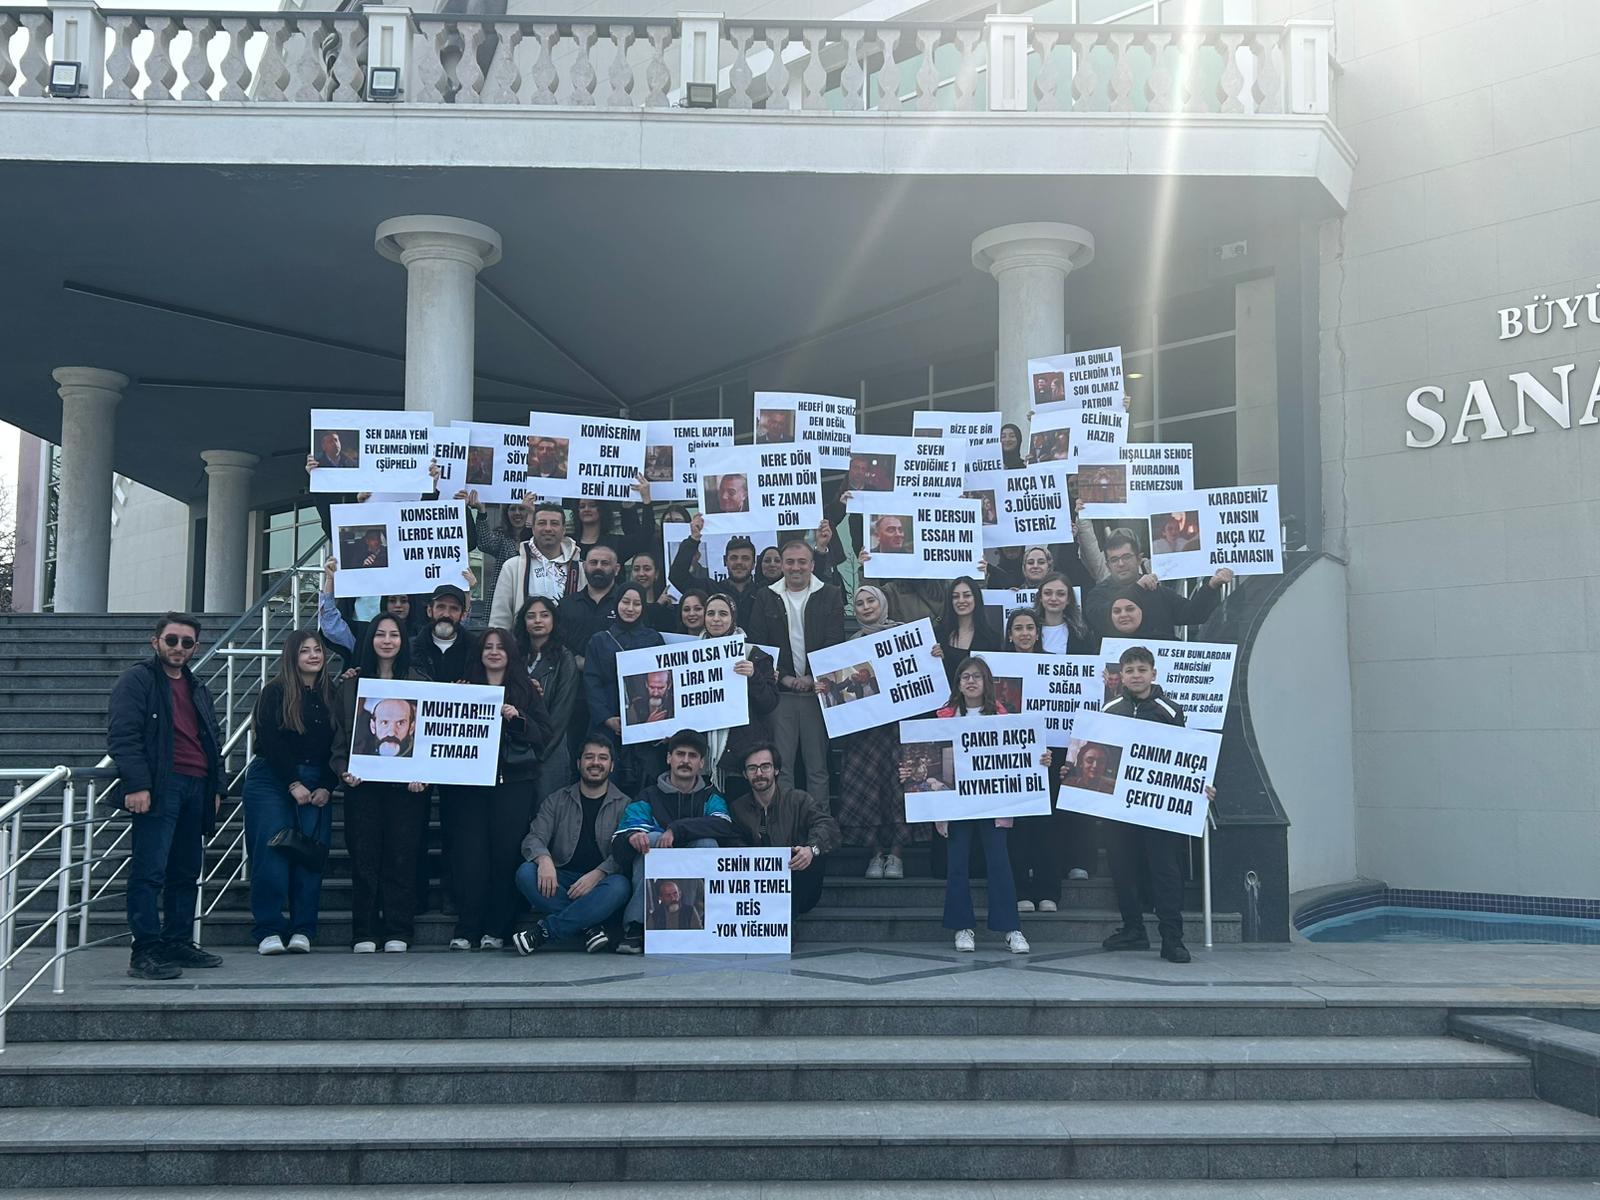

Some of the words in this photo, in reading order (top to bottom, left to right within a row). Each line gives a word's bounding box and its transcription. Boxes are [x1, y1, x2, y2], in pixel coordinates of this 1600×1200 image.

[1075, 356, 1086, 366] HA
[1088, 352, 1114, 364] BUNLA
[1070, 367, 1108, 382] EVLENDİM
[1111, 366, 1121, 376] YA
[1074, 385, 1089, 396] SON
[1092, 382, 1119, 394] OLMAZ
[798, 401, 824, 412] HEDEFİ
[826, 404, 835, 413] ON
[838, 404, 856, 416] SEKİZ
[1082, 397, 1112, 408] PATRON
[810, 416, 824, 426] DEN
[826, 416, 845, 428] DEĞİL
[1082, 412, 1122, 428] GELİNLİK
[366, 429, 382, 440] SEN
[384, 429, 407, 440] DAHA
[410, 428, 428, 440] YENİ
[581, 424, 640, 442] KOMİSERİM
[674, 427, 700, 438] TEMEL
[702, 426, 732, 437] KAPTAN
[802, 430, 851, 443] KALBİMİZDEN
[950, 424, 966, 434] BİZE
[968, 426, 978, 434] DE
[980, 424, 992, 434] BİR
[1087, 430, 1114, 443] HAZIR
[365, 443, 428, 454] EVLENMEDİNMİ
[433, 442, 466, 460] ERİM
[600, 445, 620, 458] BEN
[818, 446, 830, 456] UN
[917, 444, 944, 456] SEVEN
[1119, 446, 1161, 462] İNŞALLAH
[1164, 448, 1192, 460] SENDE
[376, 457, 417, 472] (ŞÜPHELİ)
[761, 454, 787, 467] NERE
[790, 450, 811, 466] DÖN
[904, 458, 948, 472] SEVDİĞİNE
[951, 462, 956, 472] 1
[972, 459, 1002, 472] GÜZELE
[578, 463, 638, 479] PATLATTUM
[1132, 465, 1180, 475] MURADINA
[758, 473, 792, 487] BAAMI
[796, 470, 817, 485] DÖN
[896, 474, 920, 487] TEPSİ
[922, 477, 962, 488] BAKLAVA
[1007, 476, 1037, 494] AKÇA
[1040, 475, 1056, 489] YA
[1130, 480, 1183, 491] EREMEZSUN
[581, 481, 604, 496] BENİ
[607, 483, 630, 498] ALIN
[1208, 488, 1268, 506] KARADENİZ
[762, 494, 775, 507] NE
[778, 492, 816, 506] ZAMAN
[1004, 493, 1062, 513] 3.DÜĞÜNÜ
[400, 505, 459, 522] KOMSERİM
[778, 510, 799, 526] DÖN
[918, 508, 931, 522] NE
[935, 509, 976, 523] DERSUN
[1219, 510, 1258, 524] YANSIN
[1015, 514, 1056, 532] İSTERİZ
[398, 526, 434, 541] İLERDE
[437, 526, 464, 540] KAZA
[922, 529, 955, 542] ESSAH
[960, 530, 973, 543] MI
[1216, 530, 1245, 548] AKÇA
[1248, 530, 1266, 543] KIZ
[403, 547, 424, 560] VAR
[427, 546, 461, 562] YAVAŞ
[924, 548, 972, 562] DERSUNN
[1210, 548, 1274, 564] AĞLAMASIN
[425, 564, 441, 579] GİT
[1016, 593, 1028, 604] HA
[874, 639, 893, 659] BU
[893, 628, 923, 653] İKİLİ
[656, 650, 689, 669] YAKIN
[692, 646, 720, 664] OLSA
[723, 640, 744, 658] YÜZ
[1158, 648, 1169, 657] KIZ
[1171, 649, 1185, 658] SEN
[1187, 650, 1231, 660] BUNLARDAN
[893, 654, 918, 678] BİZİ
[1038, 664, 1050, 675] NE
[1053, 662, 1079, 677] SAĞA
[1082, 665, 1095, 677] NE
[680, 669, 704, 687] LİRA
[708, 667, 723, 682] MI
[1166, 673, 1214, 684] İSTİYORSUN?
[889, 674, 934, 704] BİTİRİİİ
[1049, 680, 1082, 695] SAĞAA
[681, 687, 724, 708] DERDİM
[1191, 693, 1223, 701] BUNLARA
[422, 700, 496, 720] MUHTAR!!!!
[1199, 704, 1223, 713] SOĞUK
[424, 722, 489, 738] MUHTARIM
[961, 731, 998, 752] ÇAKIR
[1003, 728, 1036, 749] AKÇA
[430, 744, 478, 759] ETMAAA
[1130, 743, 1172, 765] CANIM
[1174, 752, 1208, 774] AKÇA
[972, 752, 1032, 771] KIZIMIZIN
[958, 774, 1022, 796] KIYMETİNİ
[1026, 773, 1045, 792] BİL
[1124, 765, 1144, 782] KIZ
[1147, 770, 1206, 794] SARMASİ
[1126, 789, 1164, 809] ÇEKTU
[1167, 796, 1193, 816] DAA
[717, 855, 750, 872] SENİN
[754, 857, 782, 872] KIZIN
[710, 880, 724, 894] MI
[728, 879, 750, 894] VAR
[754, 879, 791, 894] TEMEL
[736, 898, 761, 916] REİS
[712, 924, 737, 937] -YOK
[740, 921, 788, 937] YİĞENUM
